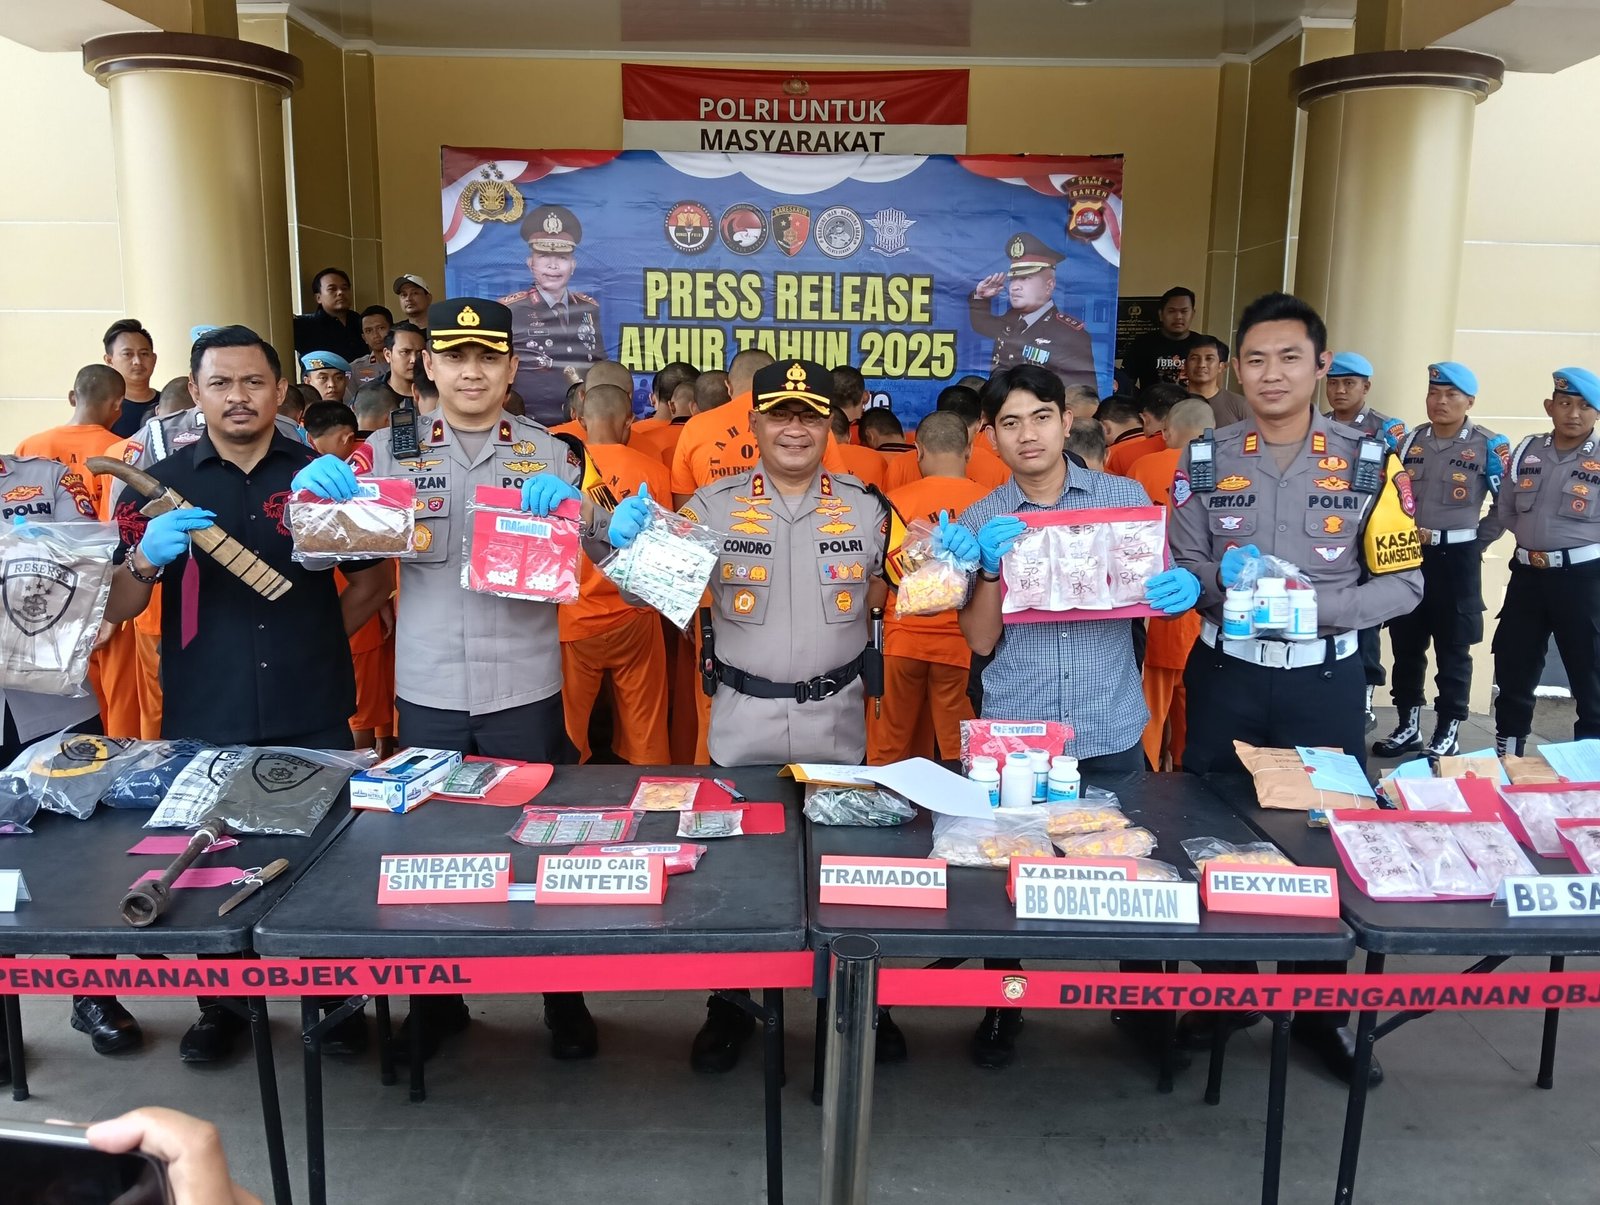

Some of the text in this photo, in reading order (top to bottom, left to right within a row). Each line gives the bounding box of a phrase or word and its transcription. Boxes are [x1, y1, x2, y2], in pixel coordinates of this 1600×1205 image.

[700, 97, 886, 122] POLRI UNTUK
[700, 128, 886, 153] MASYARAKAT
[1072, 188, 1108, 198] BANTEN
[646, 271, 931, 322] PRESS RELEASE
[620, 326, 725, 372] AKHIR
[860, 332, 955, 378] 2025
[1449, 459, 1479, 472] POLRI
[2, 501, 52, 519] POLRI
[1308, 495, 1358, 510] POLRI
[723, 539, 772, 556] CONDRO
[819, 539, 863, 554] POLRI
[14, 562, 71, 583] RESERSE
[382, 857, 509, 874] TEMBAKAU
[547, 858, 646, 871] LIQUID CAIR
[388, 873, 495, 890] SINTETIS
[544, 874, 649, 891] SINTETIS
[821, 868, 945, 887] TRAMADOL
[1214, 874, 1329, 894] HEXYMER
[1025, 884, 1179, 919] BB OBAT-OBATAN
[1513, 883, 1558, 912] BB
[241, 965, 359, 987] OBJEK
[368, 964, 472, 985] VITAL
[1060, 984, 1282, 1007] DIREKTORAT
[1292, 985, 1531, 1007] PENGAMANAN
